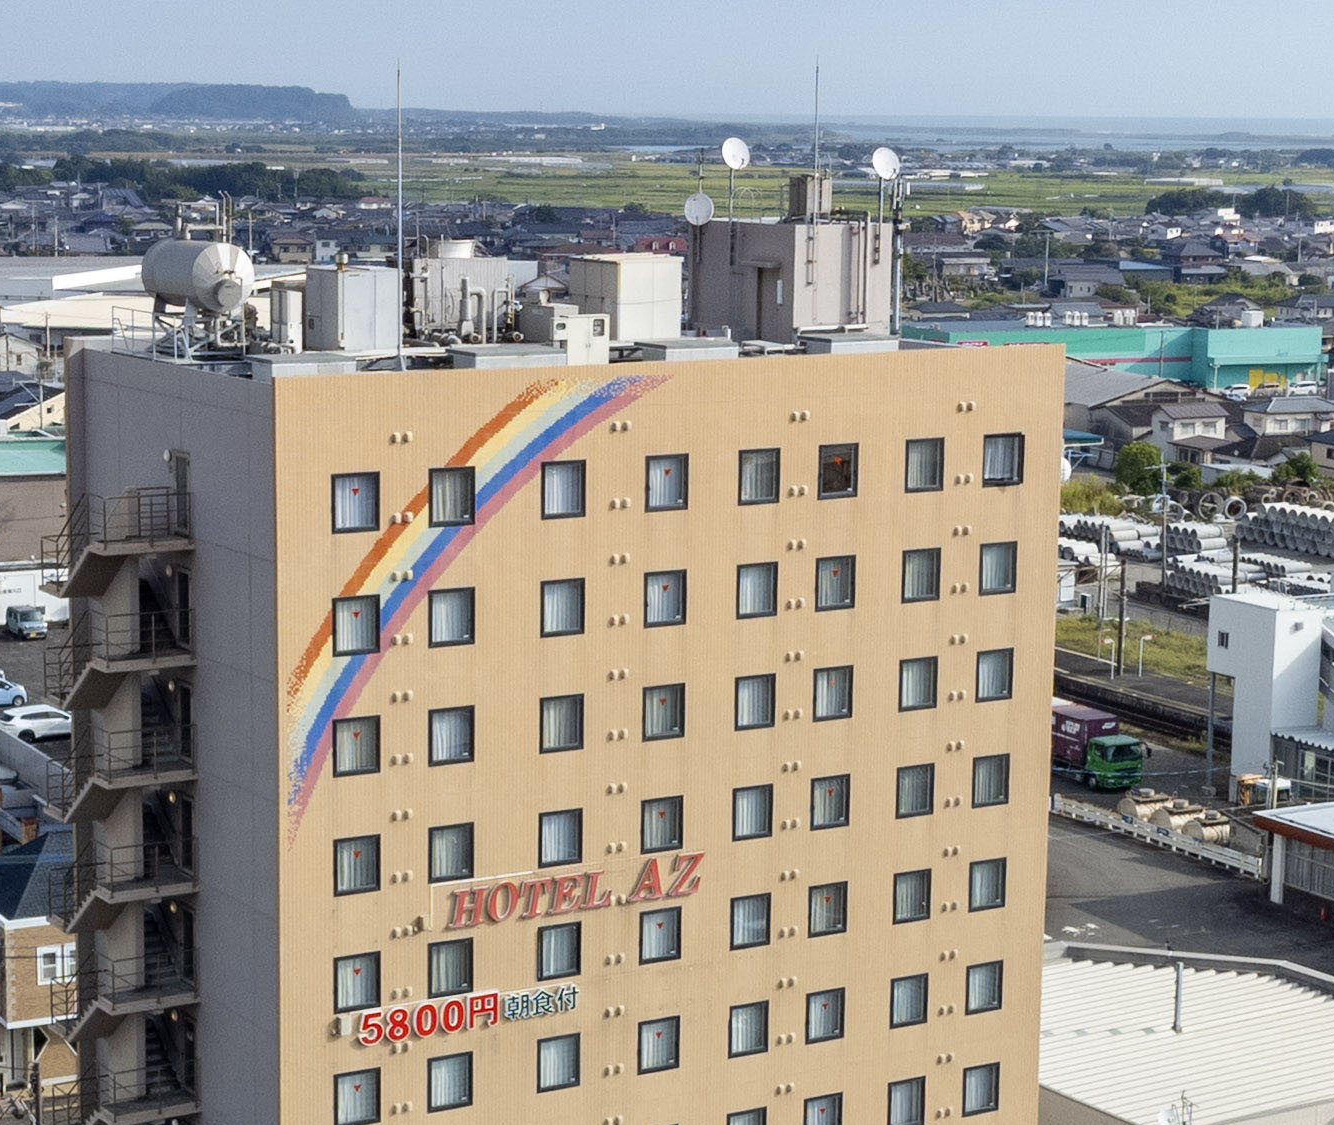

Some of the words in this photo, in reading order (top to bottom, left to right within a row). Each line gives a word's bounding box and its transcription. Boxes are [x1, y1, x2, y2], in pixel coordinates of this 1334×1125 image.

[449, 871, 611, 929] HOTEL
[630, 853, 705, 902] AZ
[358, 993, 499, 1046] 5800円
[505, 986, 578, 1020] 朝食付
